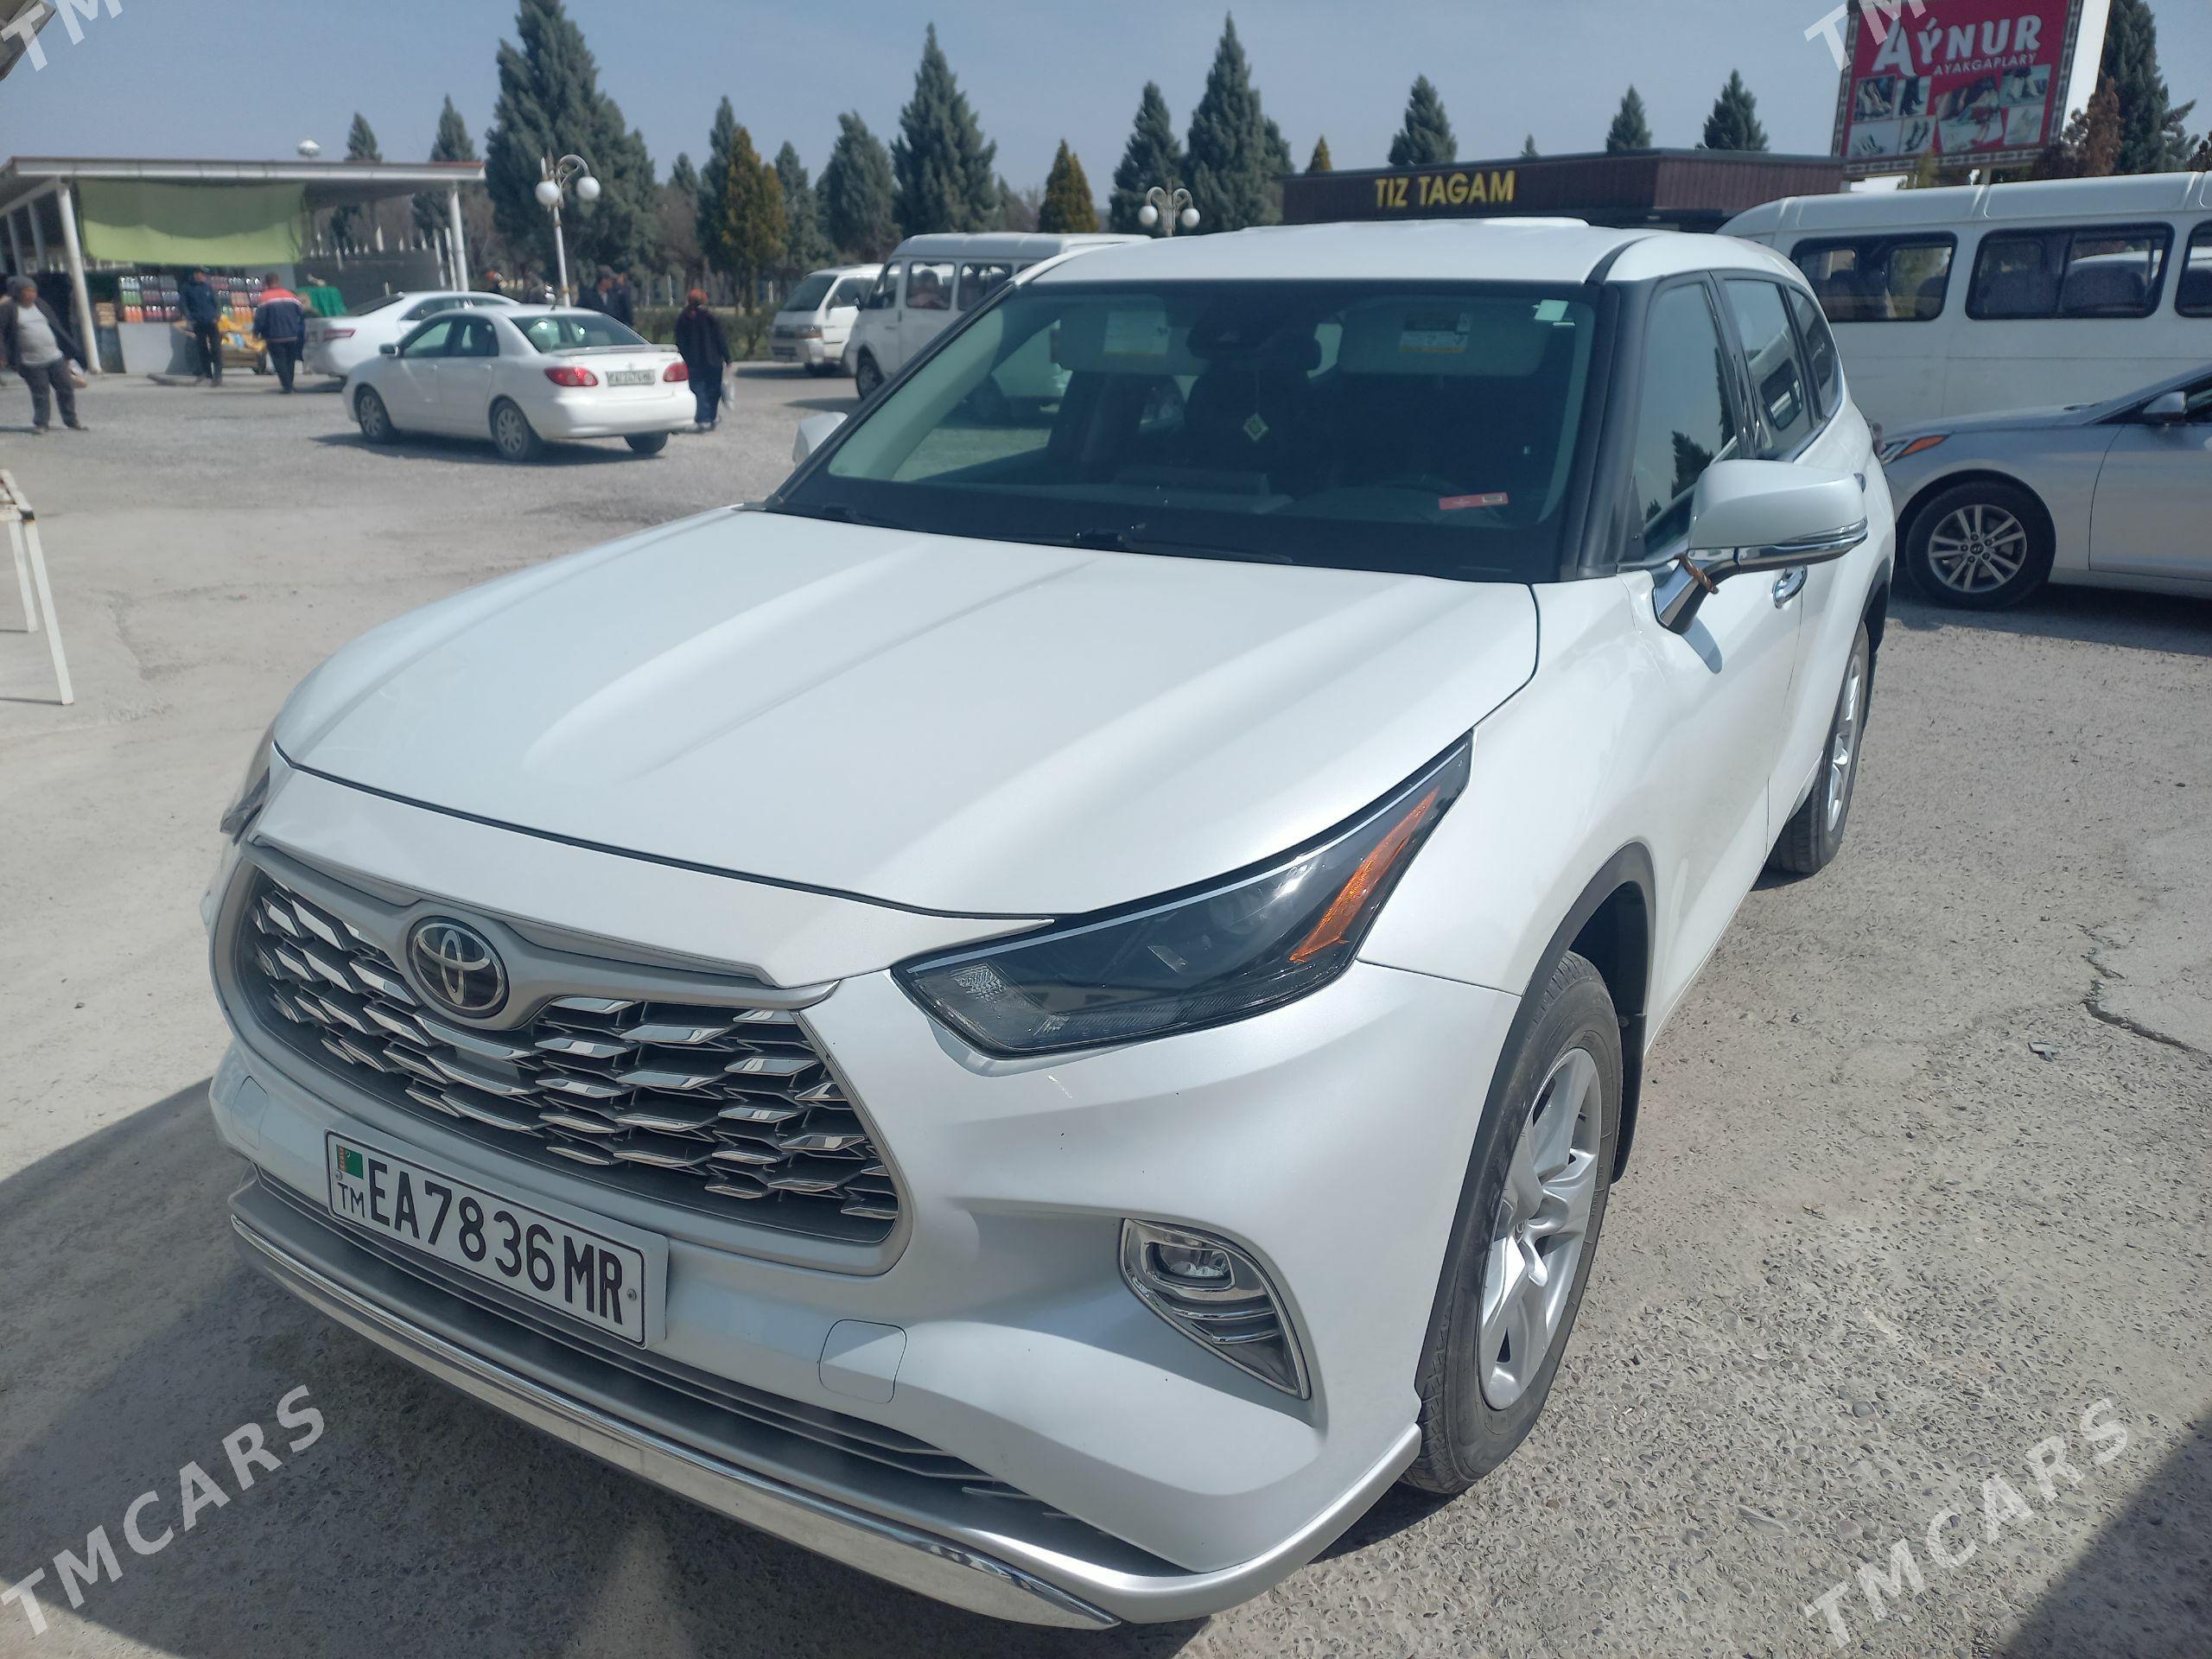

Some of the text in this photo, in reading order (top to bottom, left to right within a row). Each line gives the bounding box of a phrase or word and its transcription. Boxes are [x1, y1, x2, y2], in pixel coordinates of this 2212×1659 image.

[1872, 15, 2041, 77] AÝNUR
[1375, 170, 1516, 207] TIZ TAGAM
[337, 1158, 623, 1325] TM EA7836MR
